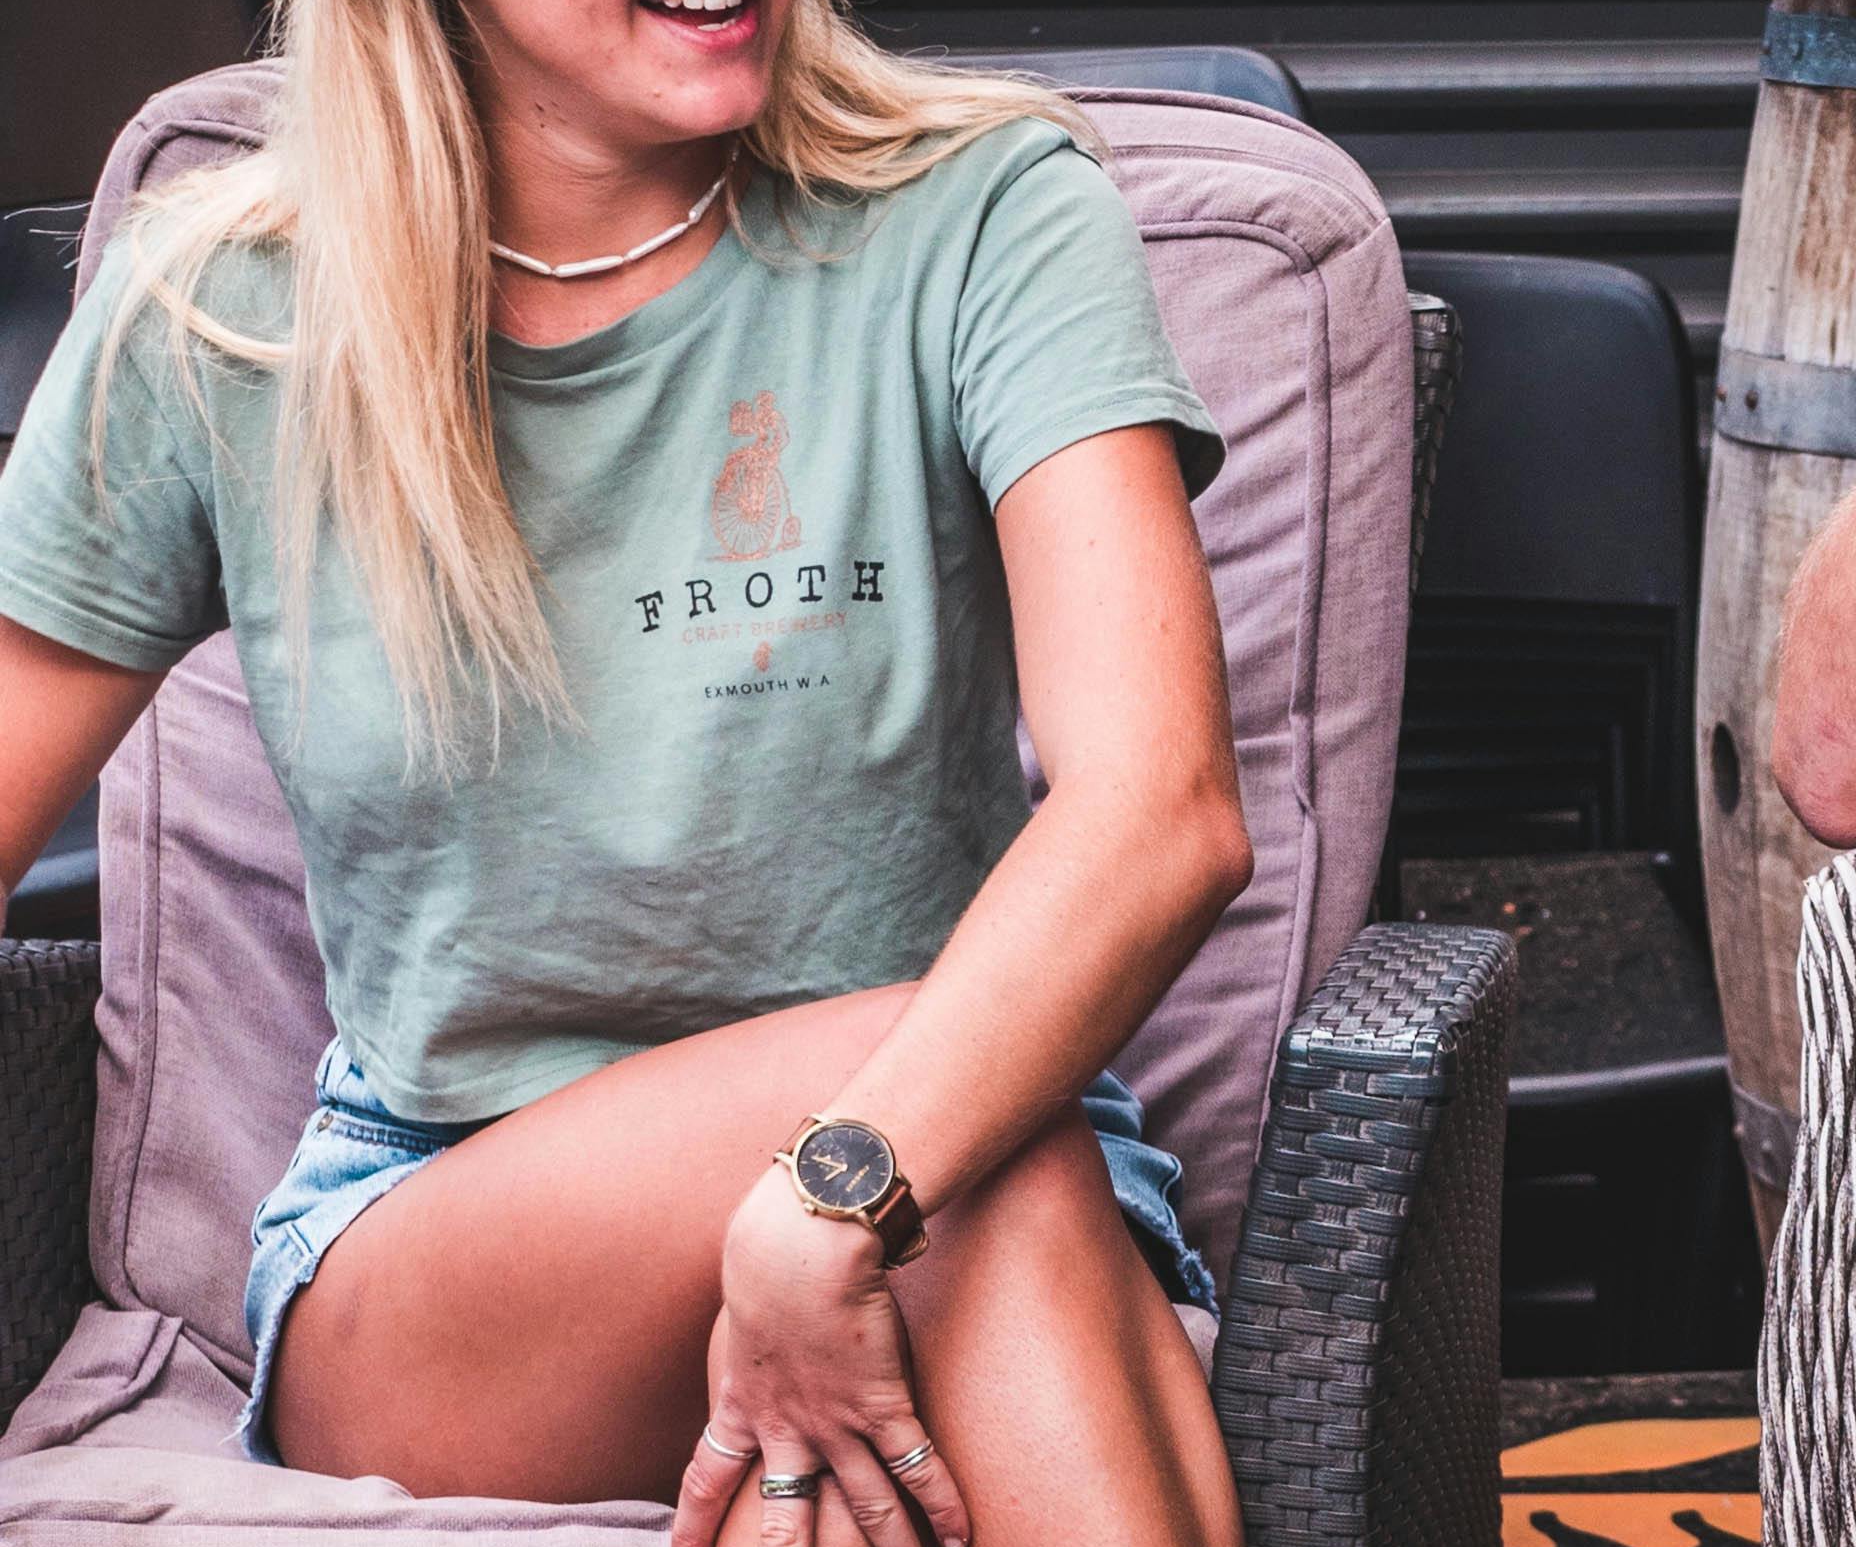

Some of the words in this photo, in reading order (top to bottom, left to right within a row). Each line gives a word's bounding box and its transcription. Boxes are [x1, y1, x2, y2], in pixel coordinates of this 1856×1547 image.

[635, 560, 885, 633] FROTH
[682, 622, 742, 644] CRAFT
[751, 612, 847, 633] BREWERY
[704, 679, 788, 699] EXMOUTH
